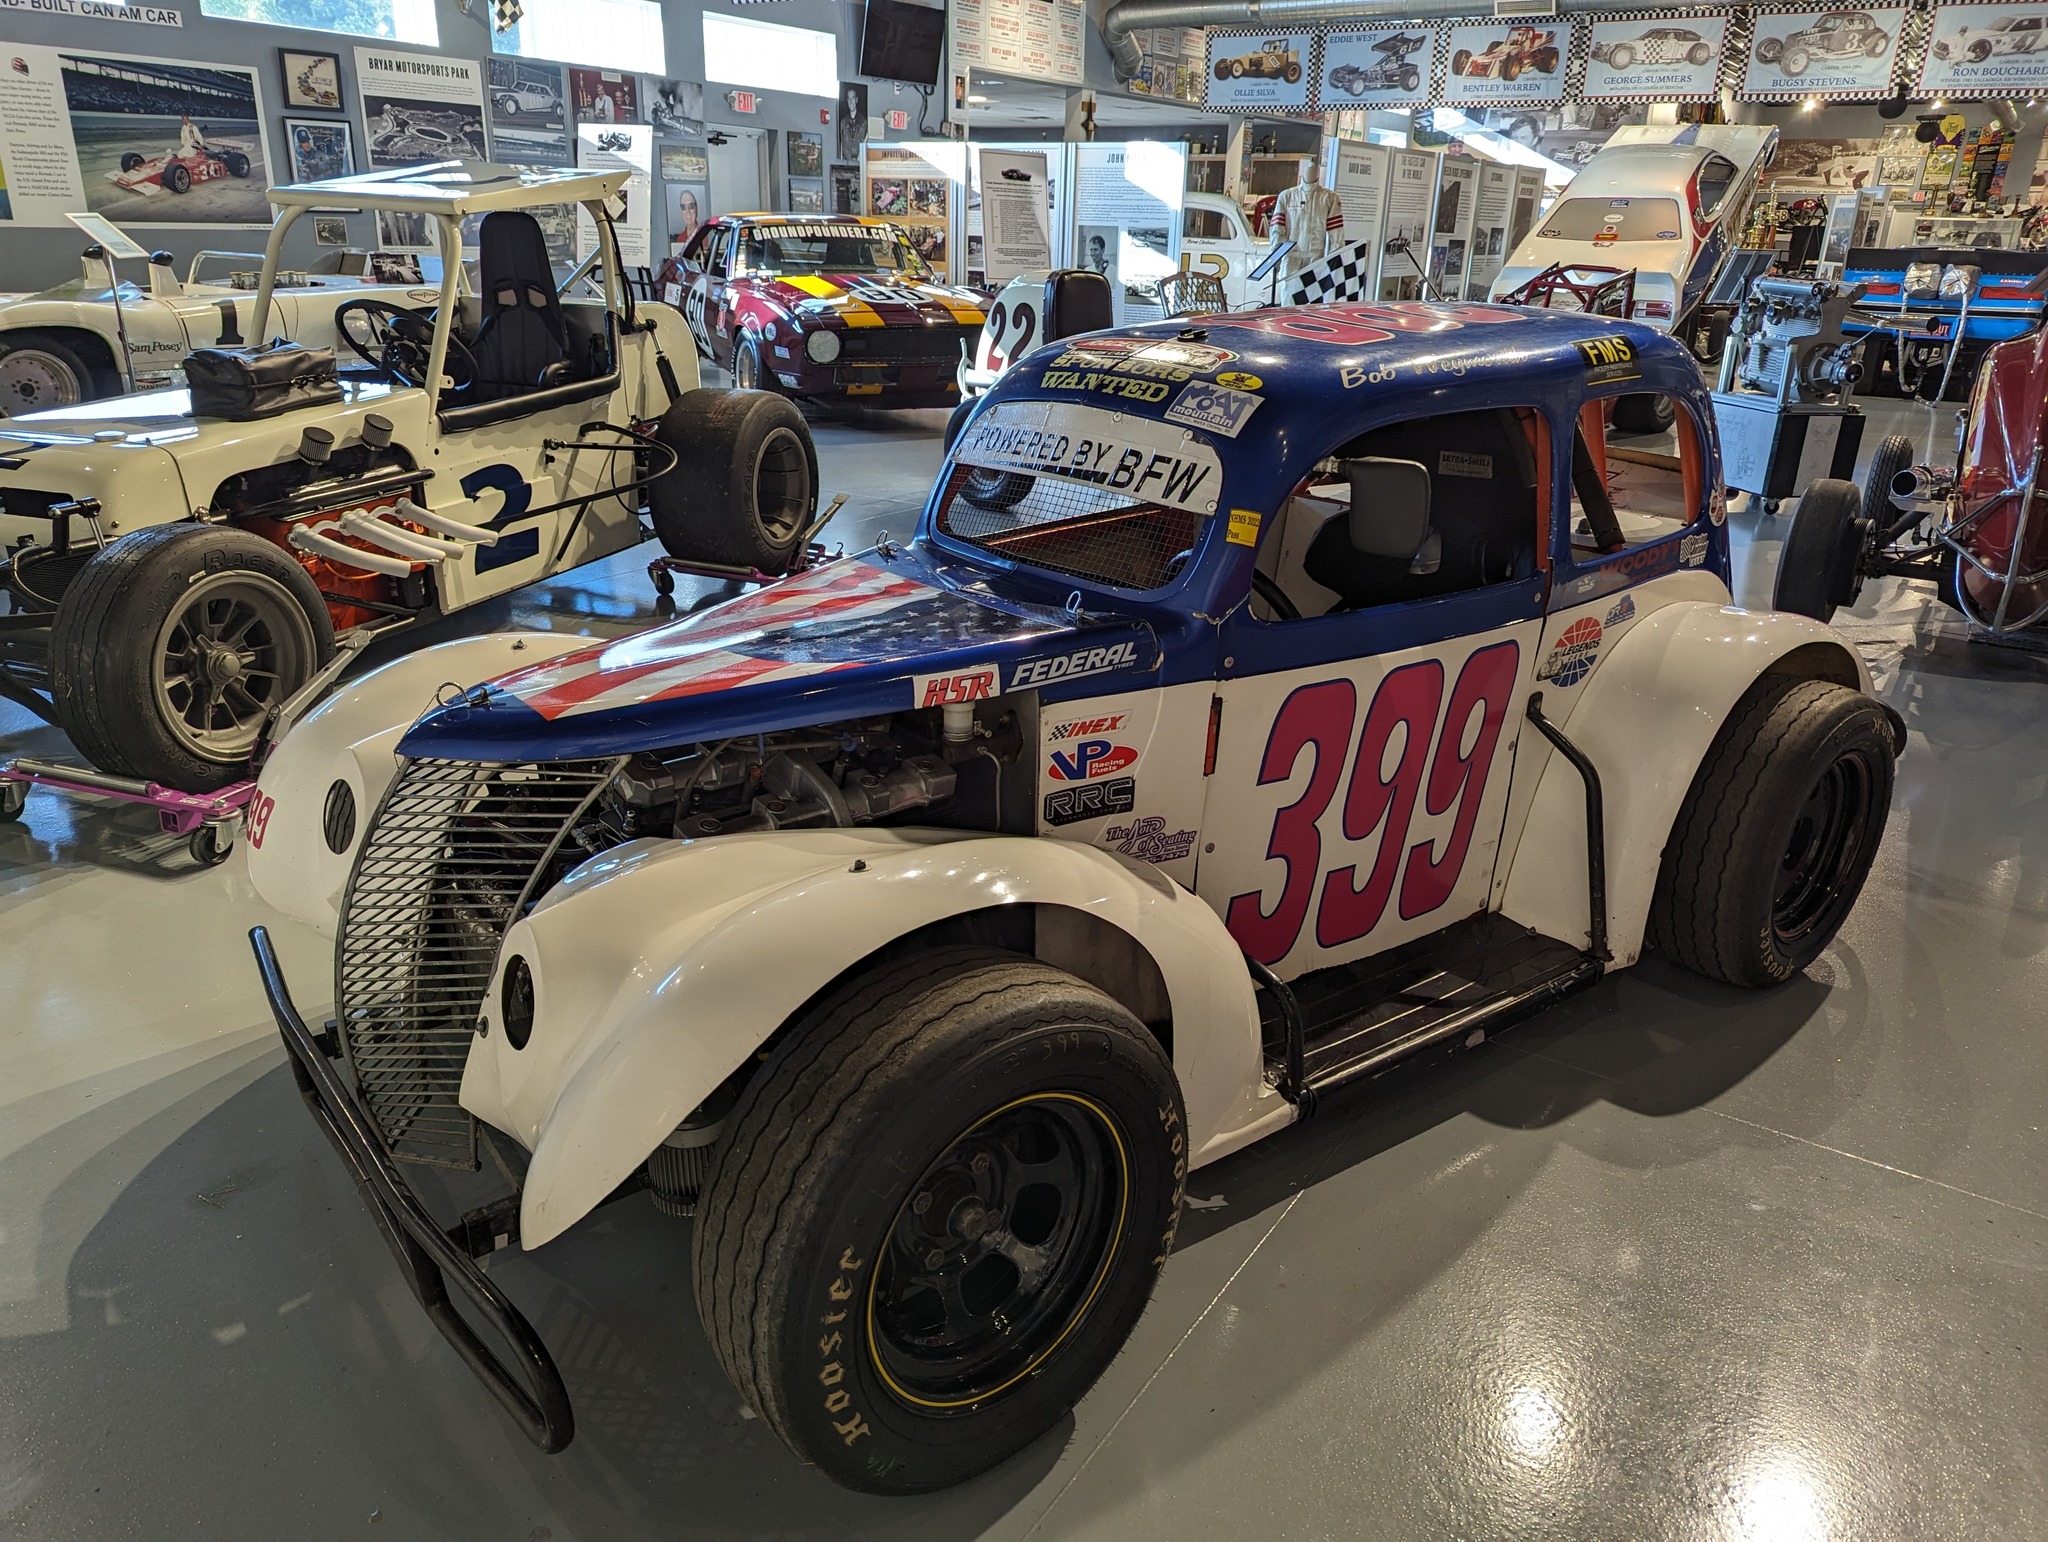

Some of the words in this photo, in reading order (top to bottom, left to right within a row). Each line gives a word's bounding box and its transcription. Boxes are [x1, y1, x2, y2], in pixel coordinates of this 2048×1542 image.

[81, 2, 114, 18] CAN
[118, 6, 142, 21] AM
[146, 9, 179, 25] CAR
[1329, 35, 1354, 44] EDDIE
[1356, 33, 1378, 43] WEST
[1399, 42, 1413, 55] 61
[368, 57, 394, 72] BRYAR
[395, 60, 450, 78] MOTORSPORTS
[451, 66, 470, 80] PARK
[1952, 67, 1979, 77] RON
[1462, 84, 1501, 93] BENTLEY
[1503, 83, 1541, 92] WARREN
[1603, 76, 1643, 85] GEORGE
[1644, 74, 1693, 83] SUMMERS
[1771, 78, 1806, 88] BUGSY
[1808, 77, 1857, 87] STEVENS
[738, 92, 754, 112] EXIT
[1234, 89, 1255, 97] OLLIE
[893, 111, 905, 128] EXIT
[1106, 153, 1125, 164] JOHN
[752, 225, 898, 243] GROUNDPOUNDERZ.COM
[210, 300, 244, 346] 1
[987, 301, 1035, 372] 22
[127, 342, 153, 355] Sam
[152, 341, 182, 353] Posey
[1581, 337, 1632, 366] FMS
[1050, 355, 1194, 383] SPONSORS
[1340, 363, 1397, 389] Bob
[137, 382, 170, 391] CHAMPION
[1040, 370, 1170, 403] WANTED
[1172, 405, 1233, 428] mountain
[973, 425, 1070, 462] POWERED
[1071, 438, 1113, 471] BY
[1106, 447, 1212, 505] BFW
[459, 463, 540, 576] 2
[1229, 512, 1247, 524] NHMS
[1247, 514, 1261, 527] 2022
[1227, 529, 1240, 540] Pass
[203, 549, 291, 581] RACER
[1561, 638, 1602, 656] LEGENDS
[1567, 650, 1589, 661] CARS
[1010, 642, 1138, 686] FEDERAL
[1113, 660, 1134, 670] TYRES
[922, 670, 994, 708] HSR
[1066, 713, 1127, 738] INEX
[1051, 738, 1113, 781] VP
[1091, 757, 1125, 770] Racing
[1091, 764, 1118, 775] Fuels
[1045, 778, 1133, 820] RRC
[1225, 639, 1520, 966] 399
[1106, 826, 1131, 842] The
[1150, 830, 1198, 855] Seating
[1043, 1031, 1080, 1061] 399
[818, 1244, 872, 1447] Hoosier
